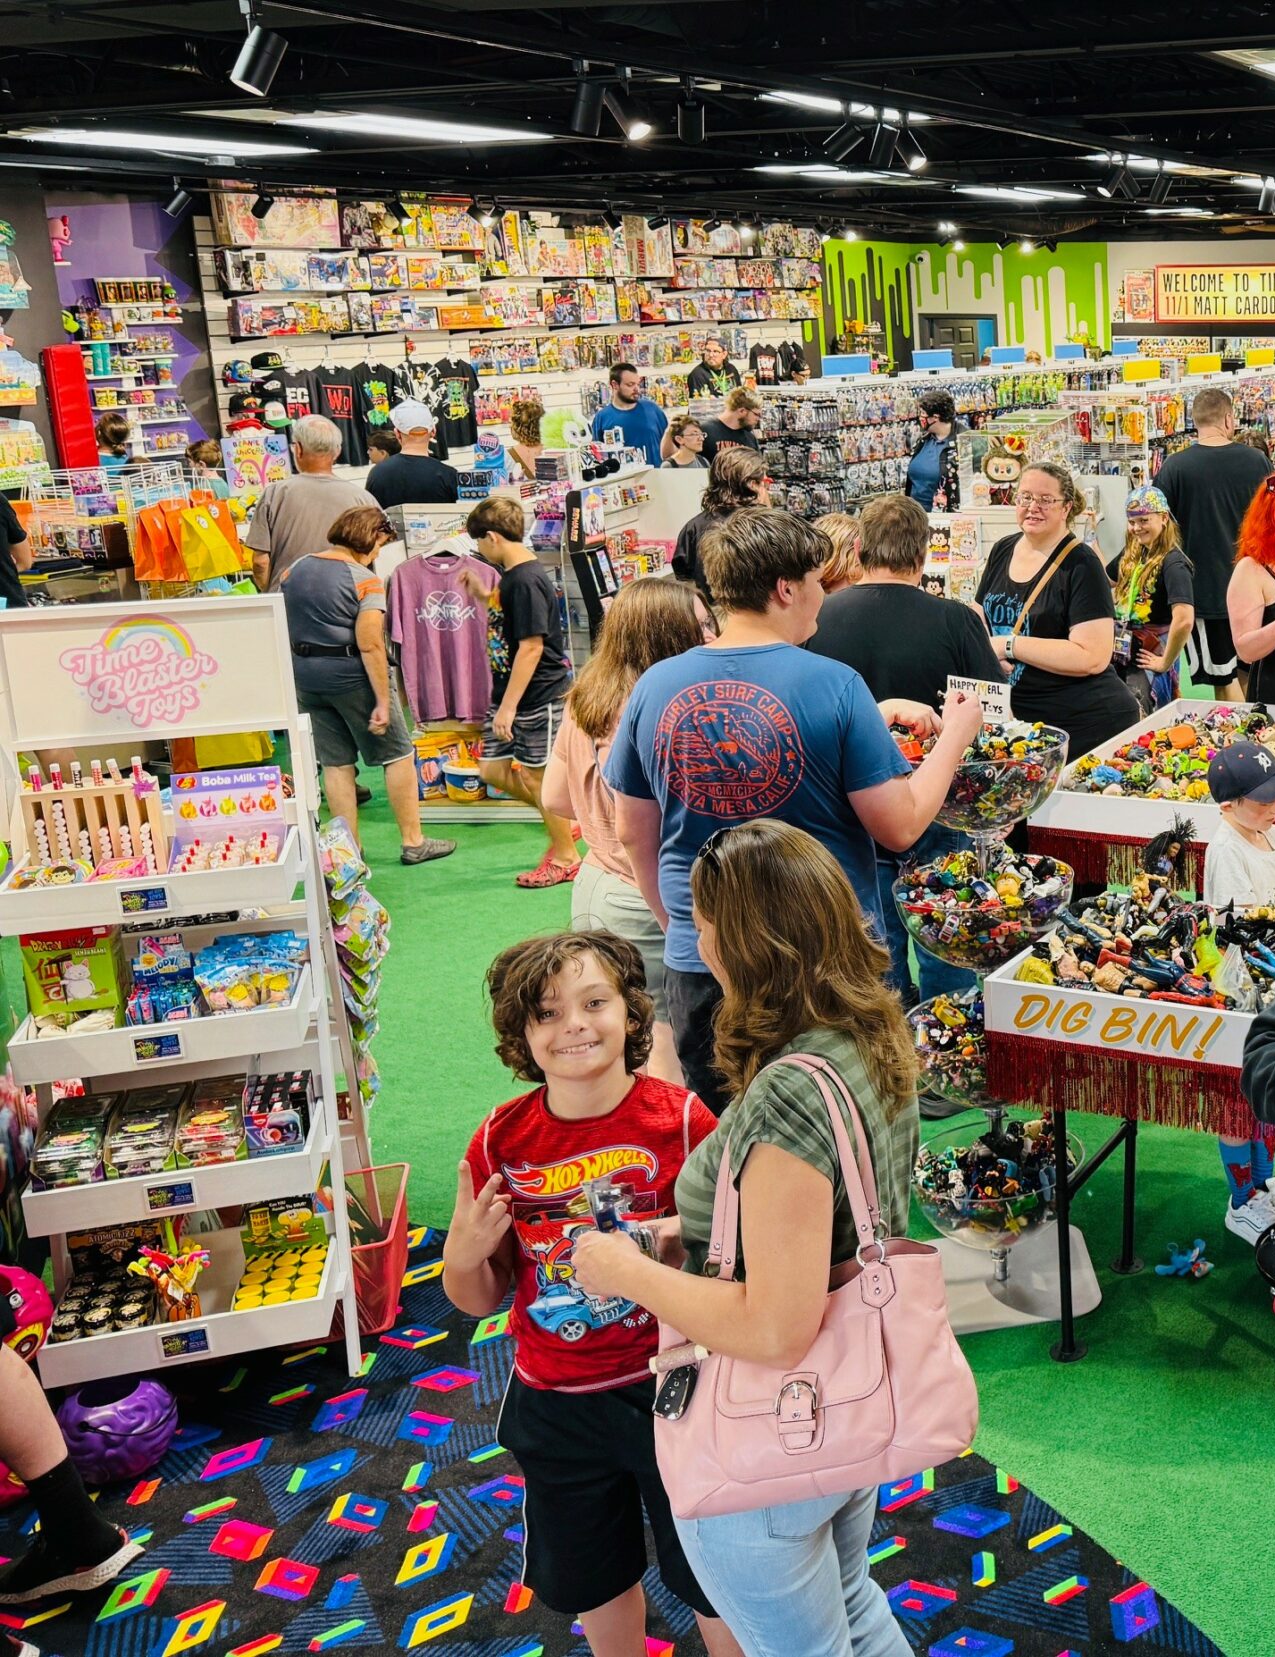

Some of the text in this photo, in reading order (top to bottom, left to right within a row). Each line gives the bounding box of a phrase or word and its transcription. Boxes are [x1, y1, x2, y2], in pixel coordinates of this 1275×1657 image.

[636, 239, 646, 273] MARVEL
[1163, 272, 1224, 292] WELCOME
[1233, 273, 1250, 292] TO
[1165, 296, 1190, 316] 11/1
[1194, 296, 1228, 315] MATT
[62, 640, 161, 684] Time
[90, 652, 217, 707] Blaster
[950, 679, 1003, 695] HAPPY MEAL
[128, 688, 198, 726] Toys
[661, 684, 794, 736] HURLEY SURF CAMP
[202, 772, 276, 786] Boba Milk Tea
[666, 771, 706, 813] COSTA
[143, 955, 177, 976] MELODY
[1013, 994, 1223, 1059] DIG BIN!
